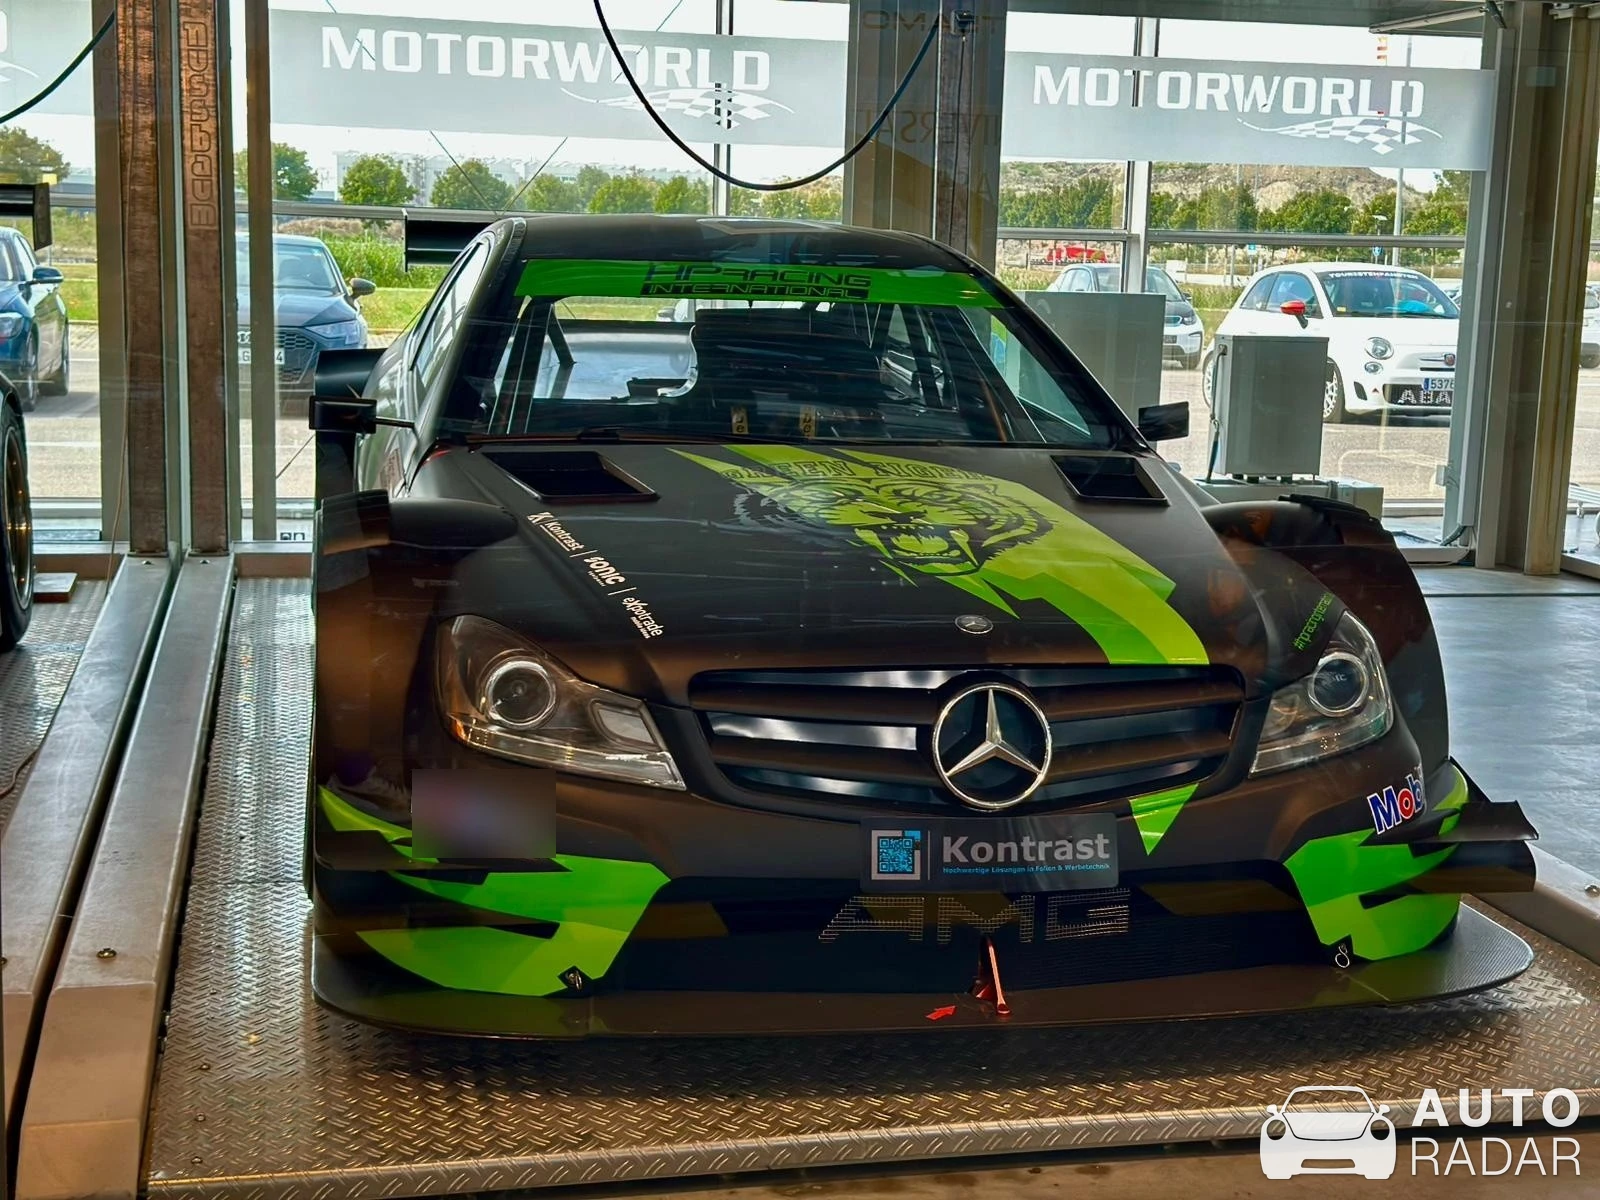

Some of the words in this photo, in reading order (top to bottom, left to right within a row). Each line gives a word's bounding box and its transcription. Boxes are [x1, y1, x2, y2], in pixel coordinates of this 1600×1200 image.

[321, 25, 771, 92] MOTORWORLD
[1032, 65, 1425, 118] MOTORWORLD
[644, 283, 868, 299] INTERNATIONAL
[544, 521, 585, 551] Kontrast
[942, 833, 1111, 863] Kontrast
[817, 888, 1132, 944] AMG
